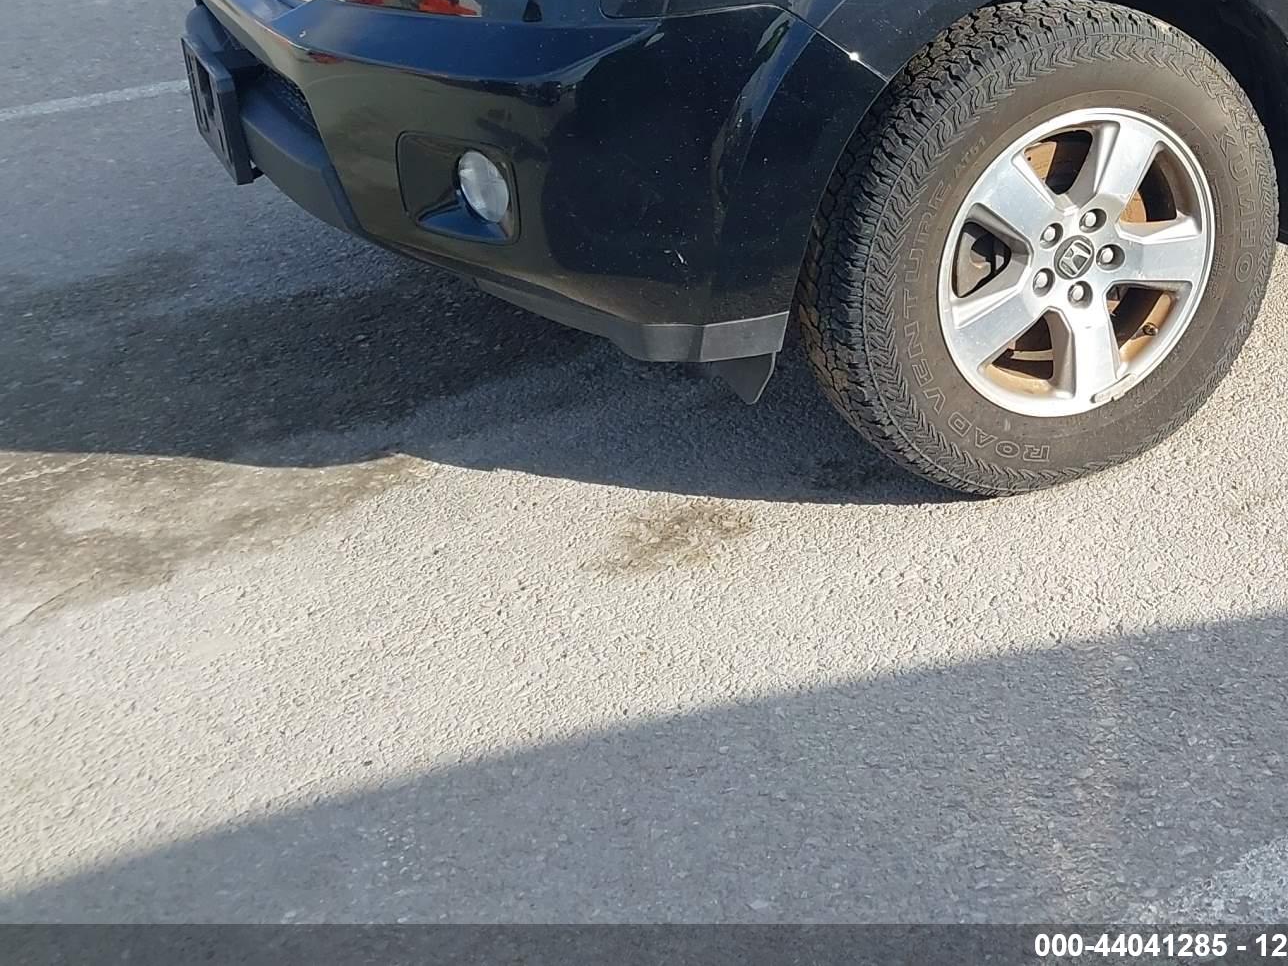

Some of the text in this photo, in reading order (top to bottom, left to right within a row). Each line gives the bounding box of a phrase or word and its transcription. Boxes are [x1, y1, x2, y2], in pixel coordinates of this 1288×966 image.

[1213, 123, 1257, 284] KUMHO
[903, 180, 950, 414] VENTURE
[946, 411, 1051, 463] ROAD
